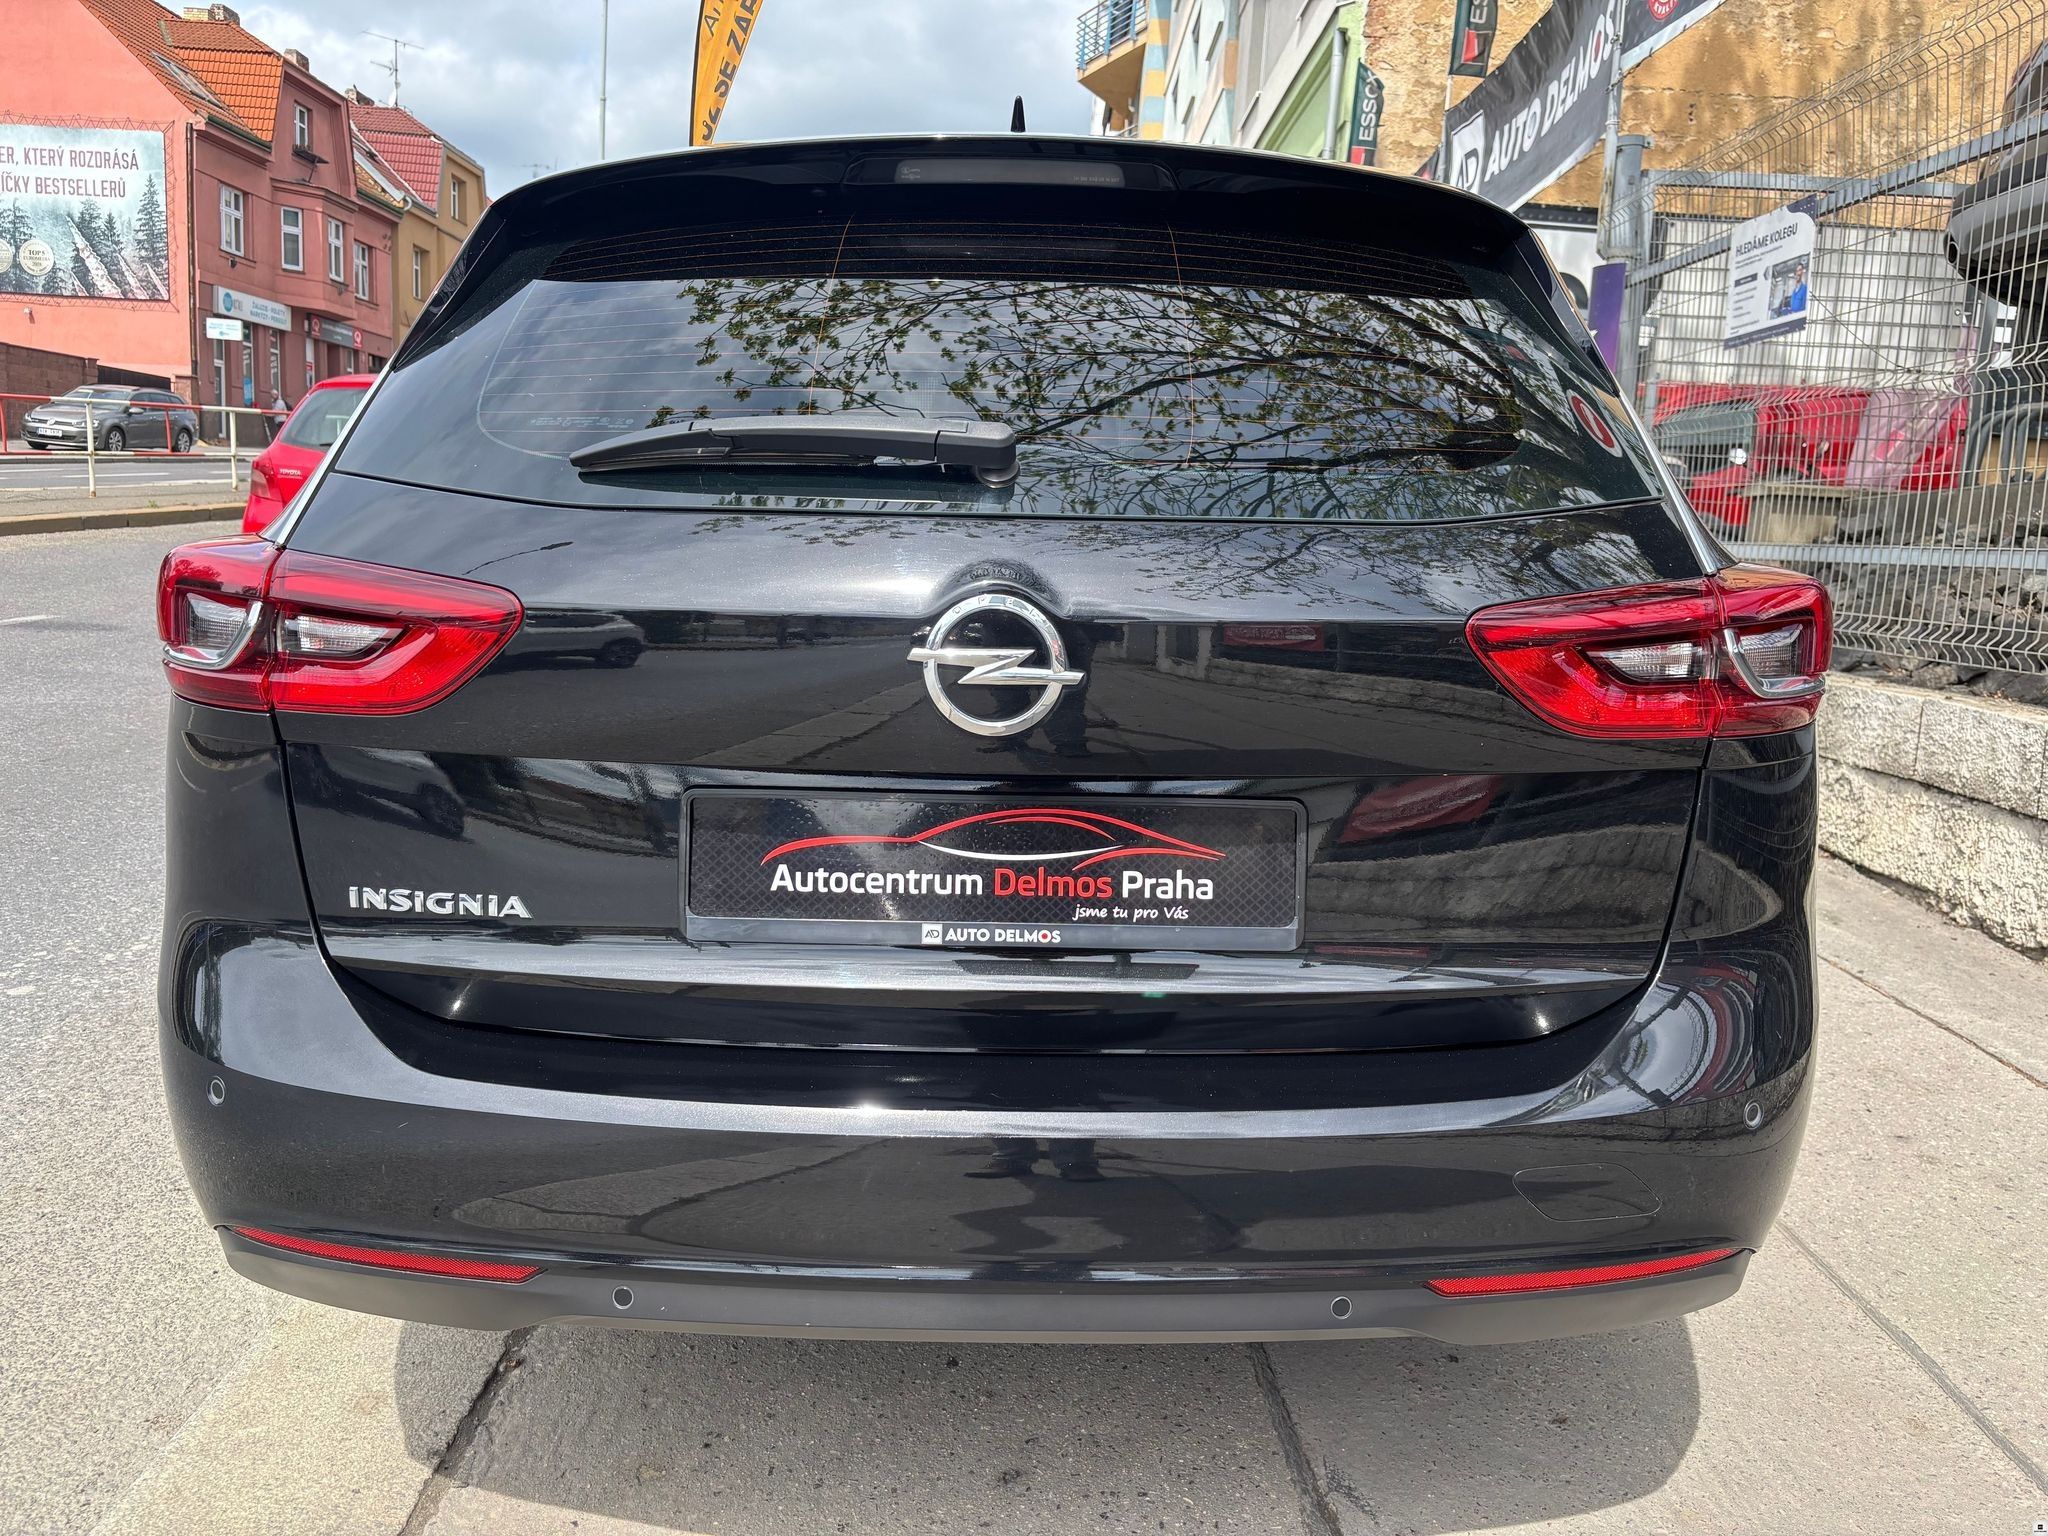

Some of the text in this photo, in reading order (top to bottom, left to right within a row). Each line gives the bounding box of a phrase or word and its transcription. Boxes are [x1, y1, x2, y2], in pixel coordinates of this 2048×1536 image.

[1484, 98, 1541, 182] AUTO
[1541, 0, 1615, 137] DELMOS
[24, 146, 64, 167] KTERÝ
[70, 148, 139, 170] ROZDRÁSÁ
[35, 177, 126, 198] BESTSELLERŮ
[1735, 234, 1770, 258] HLEDÁME
[1769, 222, 1799, 244] KOLEGU
[770, 863, 1214, 900] Autocentrum Delmos Praha
[349, 886, 534, 919] INSIGNIA
[1072, 904, 1190, 922] jsme tu pro Vás
[945, 928, 990, 942] AUTO
[994, 929, 1061, 944] DELMOS
